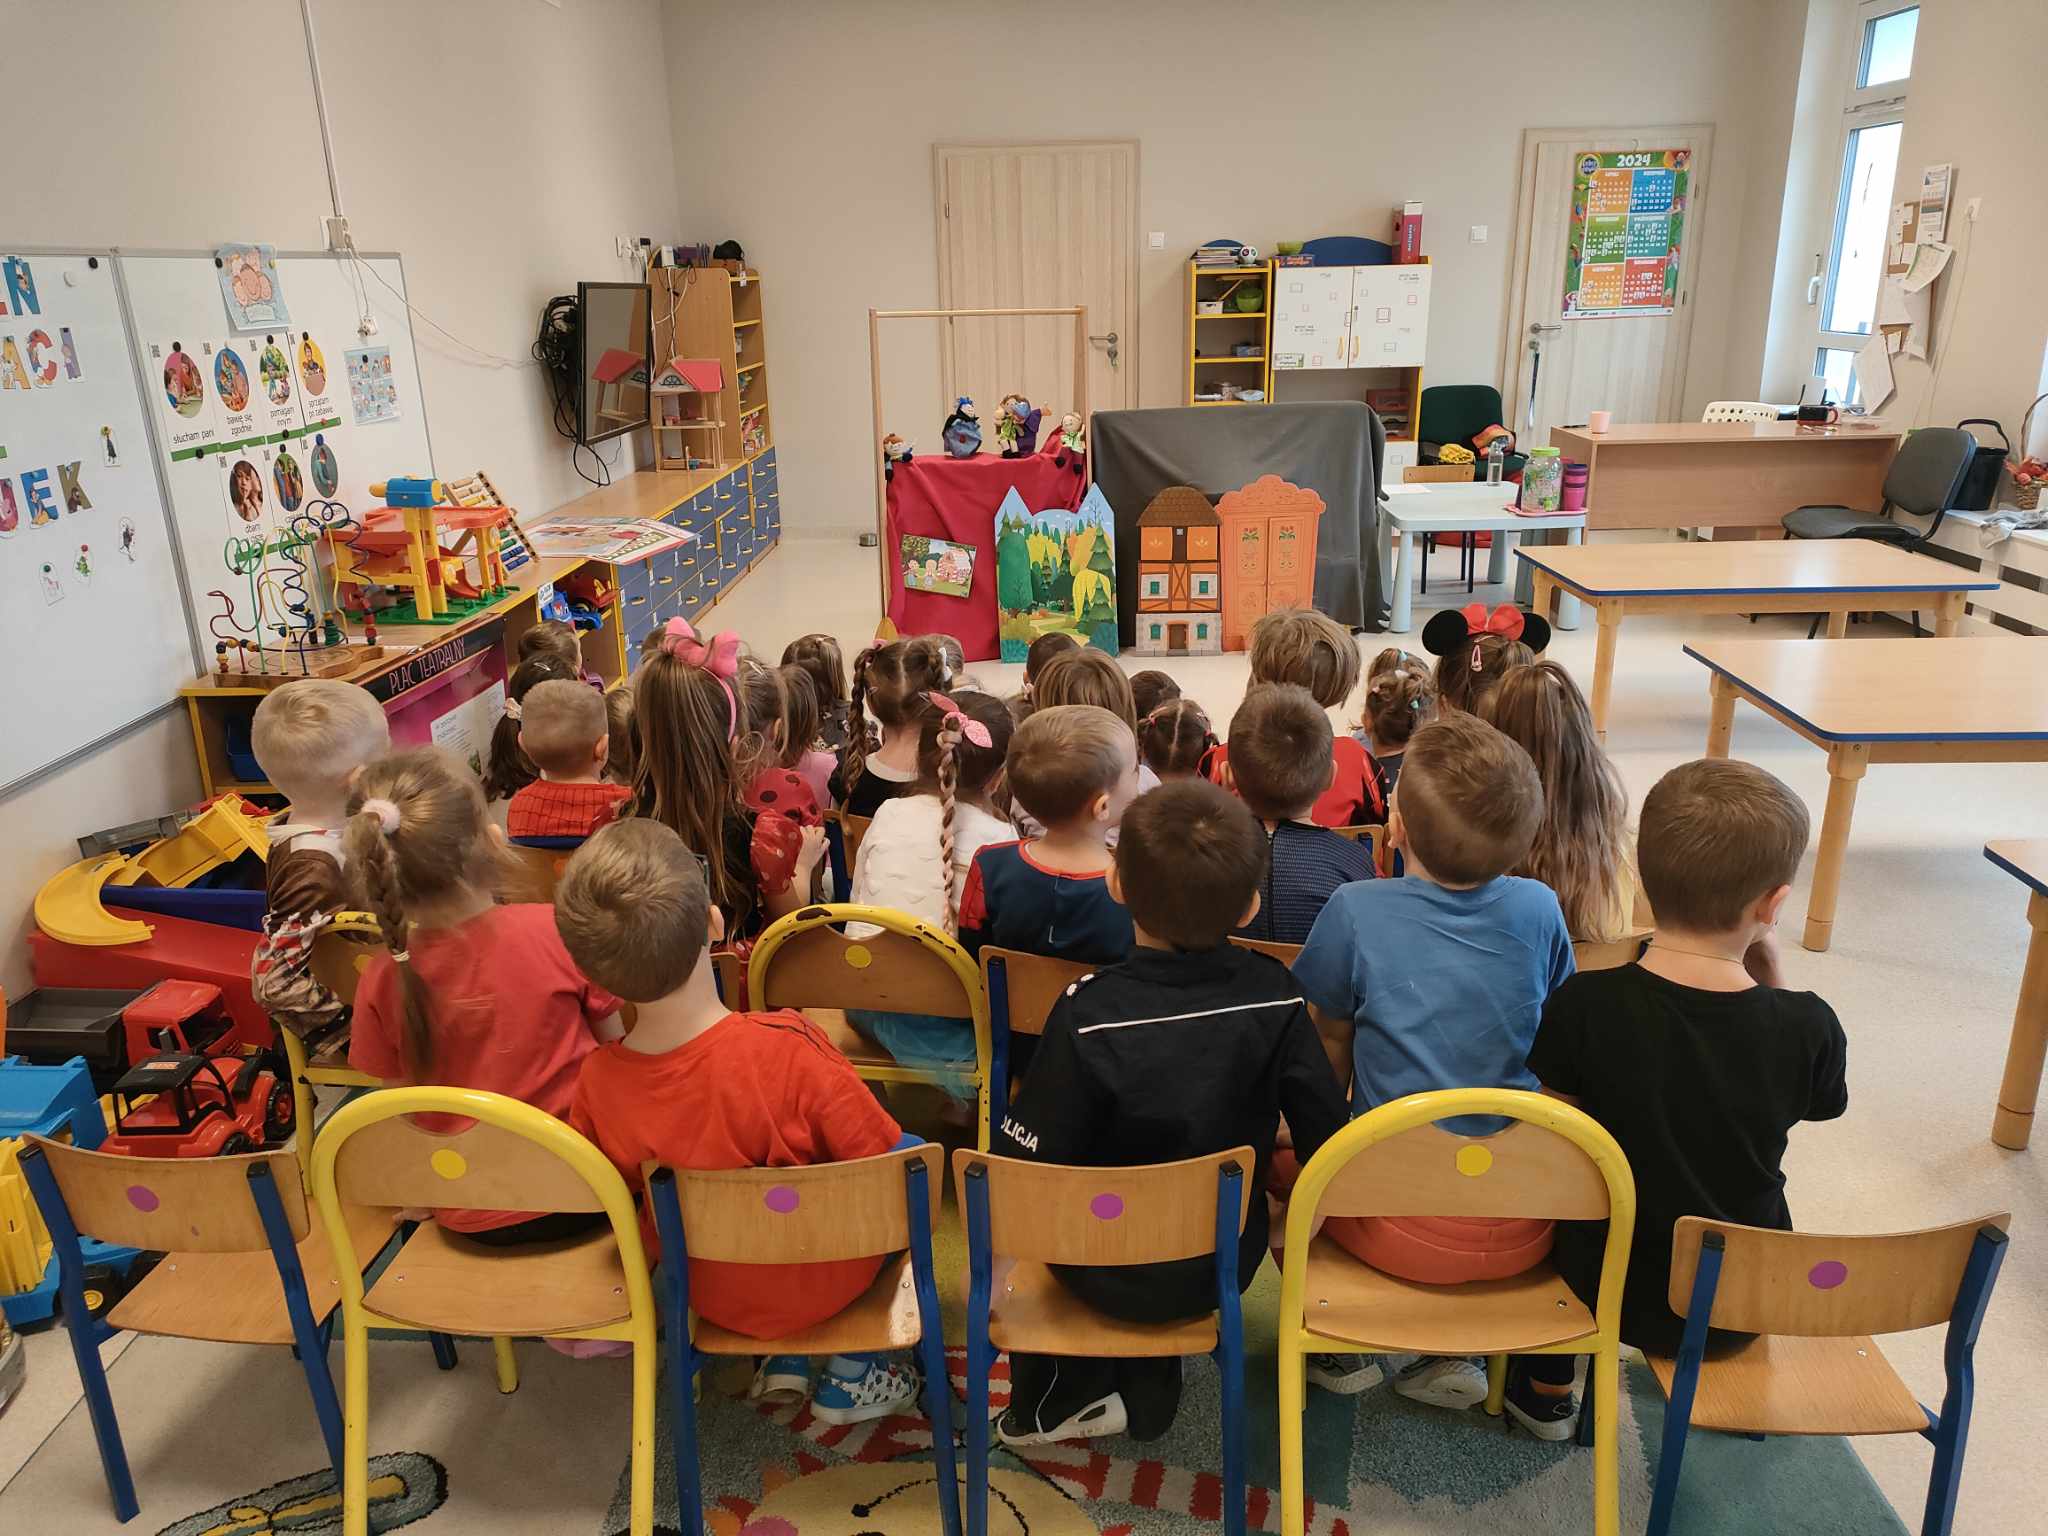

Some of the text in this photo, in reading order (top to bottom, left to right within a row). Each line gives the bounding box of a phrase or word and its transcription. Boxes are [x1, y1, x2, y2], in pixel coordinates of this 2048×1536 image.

[1617, 154, 1650, 167] 2024
[202, 429, 215, 441] pani
[389, 636, 465, 695] PLAC TEATRALNY
